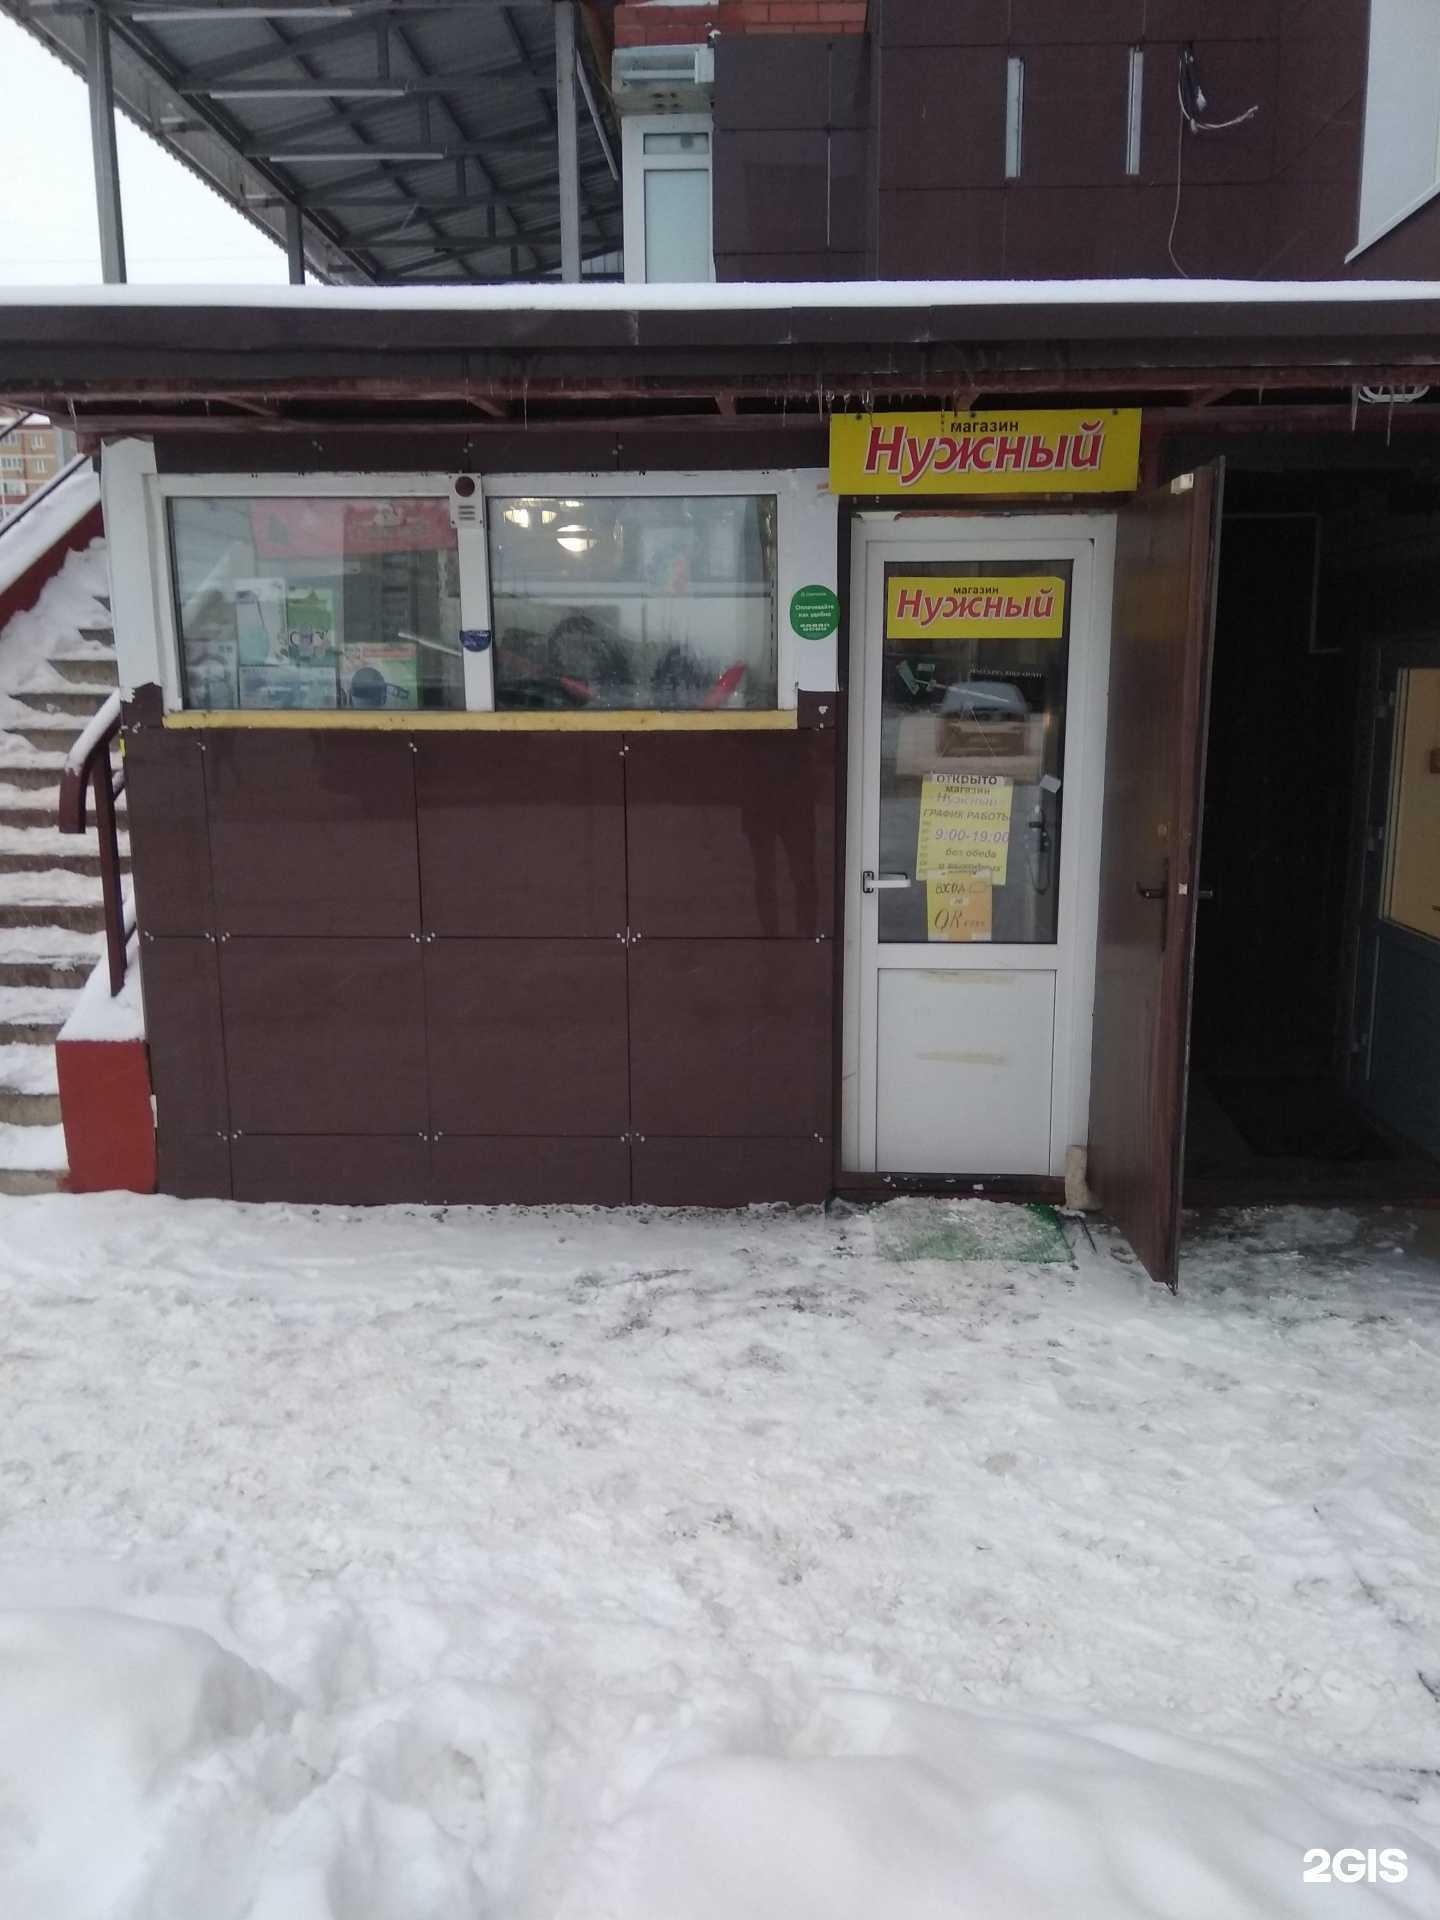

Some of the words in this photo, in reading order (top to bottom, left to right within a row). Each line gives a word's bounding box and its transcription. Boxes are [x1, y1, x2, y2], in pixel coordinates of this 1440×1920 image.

[950, 420, 1019, 433] магазин
[864, 420, 1104, 486] Нужный
[953, 586, 999, 595] магазин
[896, 587, 1056, 627] Нужный
[923, 808, 963, 818] ГРАФИК
